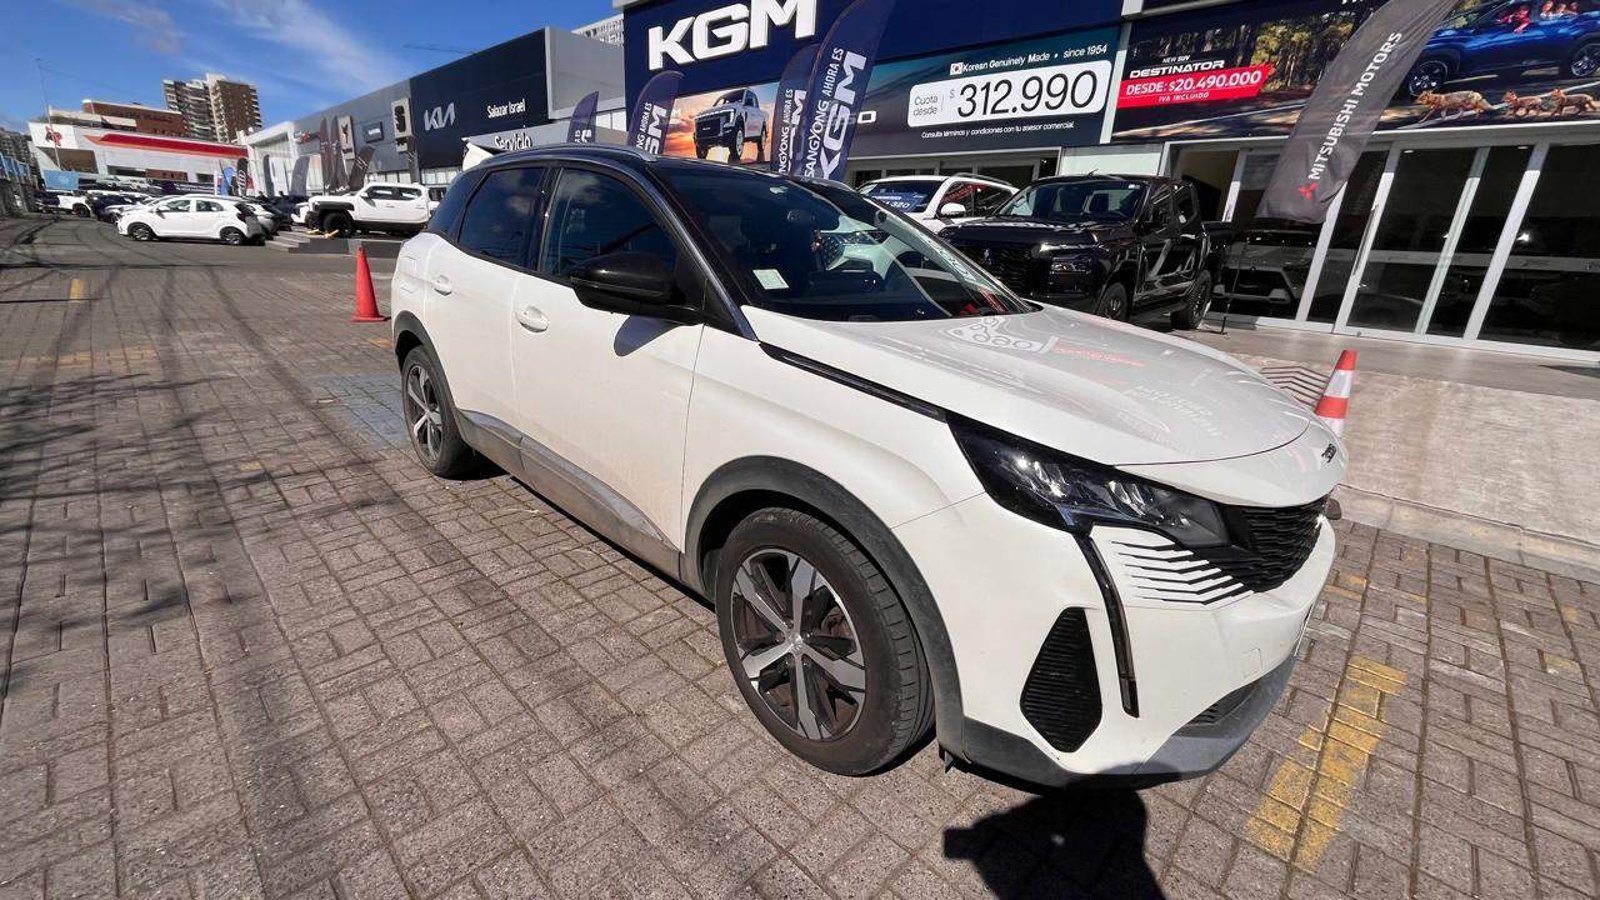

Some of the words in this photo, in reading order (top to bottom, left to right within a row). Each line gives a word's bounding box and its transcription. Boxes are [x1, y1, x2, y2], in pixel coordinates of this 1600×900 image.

[648, 0, 816, 71] KGM
[822, 62, 839, 97] AHORA
[832, 47, 844, 62] ES
[963, 62, 988, 73] Korean
[989, 56, 1025, 69] Genuinely
[1028, 53, 1050, 63] Made
[1063, 48, 1085, 58] since
[1086, 44, 1108, 56] 1954
[1130, 60, 1225, 79] DESTINATOR
[957, 70, 1098, 117] 312.990
[1126, 82, 1167, 96] DESDE:
[1169, 70, 1262, 92] $20.490.000
[487, 104, 508, 119] Salazar
[508, 98, 526, 115] Israel
[913, 106, 938, 116] desde
[915, 95, 938, 106] Cuota
[1308, 98, 1359, 180] MITSUBISHI
[1355, 32, 1403, 97] MOTORS
[424, 102, 456, 131] KIA
